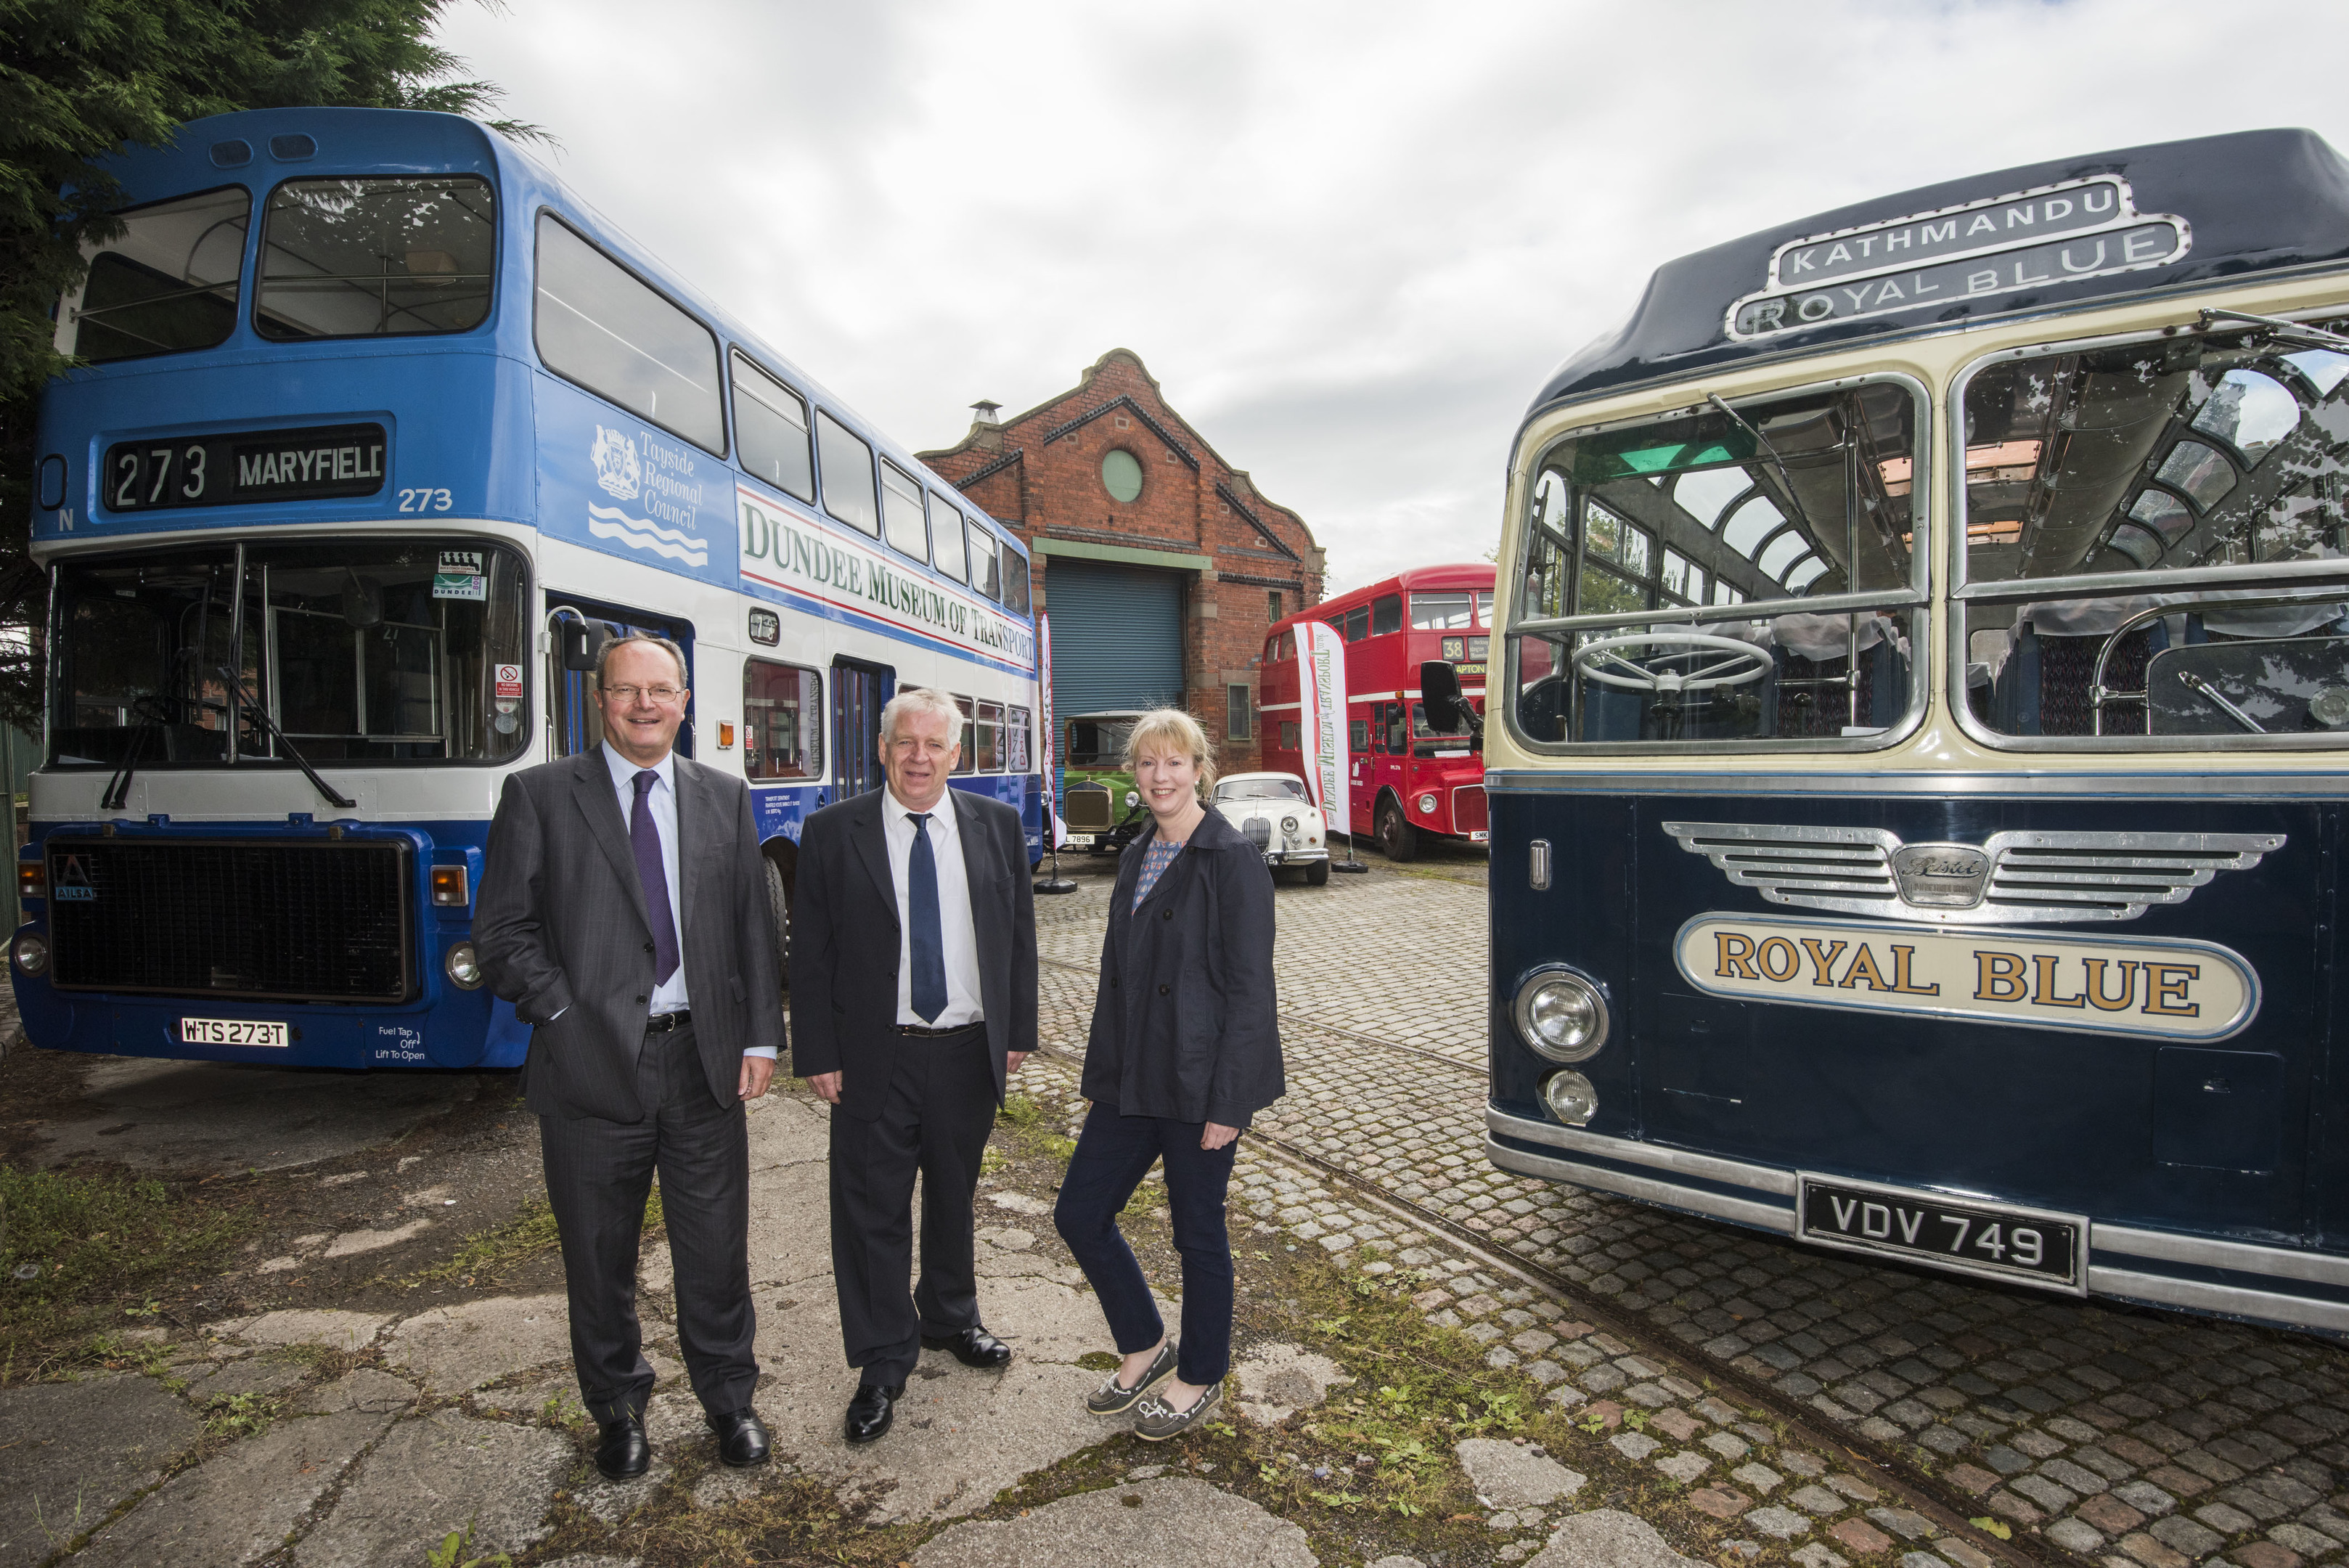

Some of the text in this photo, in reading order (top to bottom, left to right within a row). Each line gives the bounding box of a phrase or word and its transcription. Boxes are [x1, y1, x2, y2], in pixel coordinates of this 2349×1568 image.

[1793, 189, 2112, 275] KATHMANDU
[1753, 228, 2168, 333] ROYAL BLUE
[640, 430, 694, 477] Tayside
[644, 460, 703, 506] Regional
[399, 488, 452, 512] 273
[645, 489, 696, 530] Council
[60, 508, 73, 531] N
[742, 502, 1033, 661] DUNDEE MUSEUM OF TRANSPORT
[1444, 642, 1463, 658] 38
[1456, 664, 1484, 674] APTON
[1901, 856, 1982, 878] Bristol
[57, 888, 91, 898] AILSA
[1714, 931, 2199, 1018] ROYAL BLUE
[184, 1021, 284, 1045] WTS 273T
[379, 1026, 412, 1039] Fuel Tap
[400, 1040, 417, 1049] Off
[375, 1050, 425, 1062] Lift To Open
[1830, 1196, 2043, 1266] VDV 749
